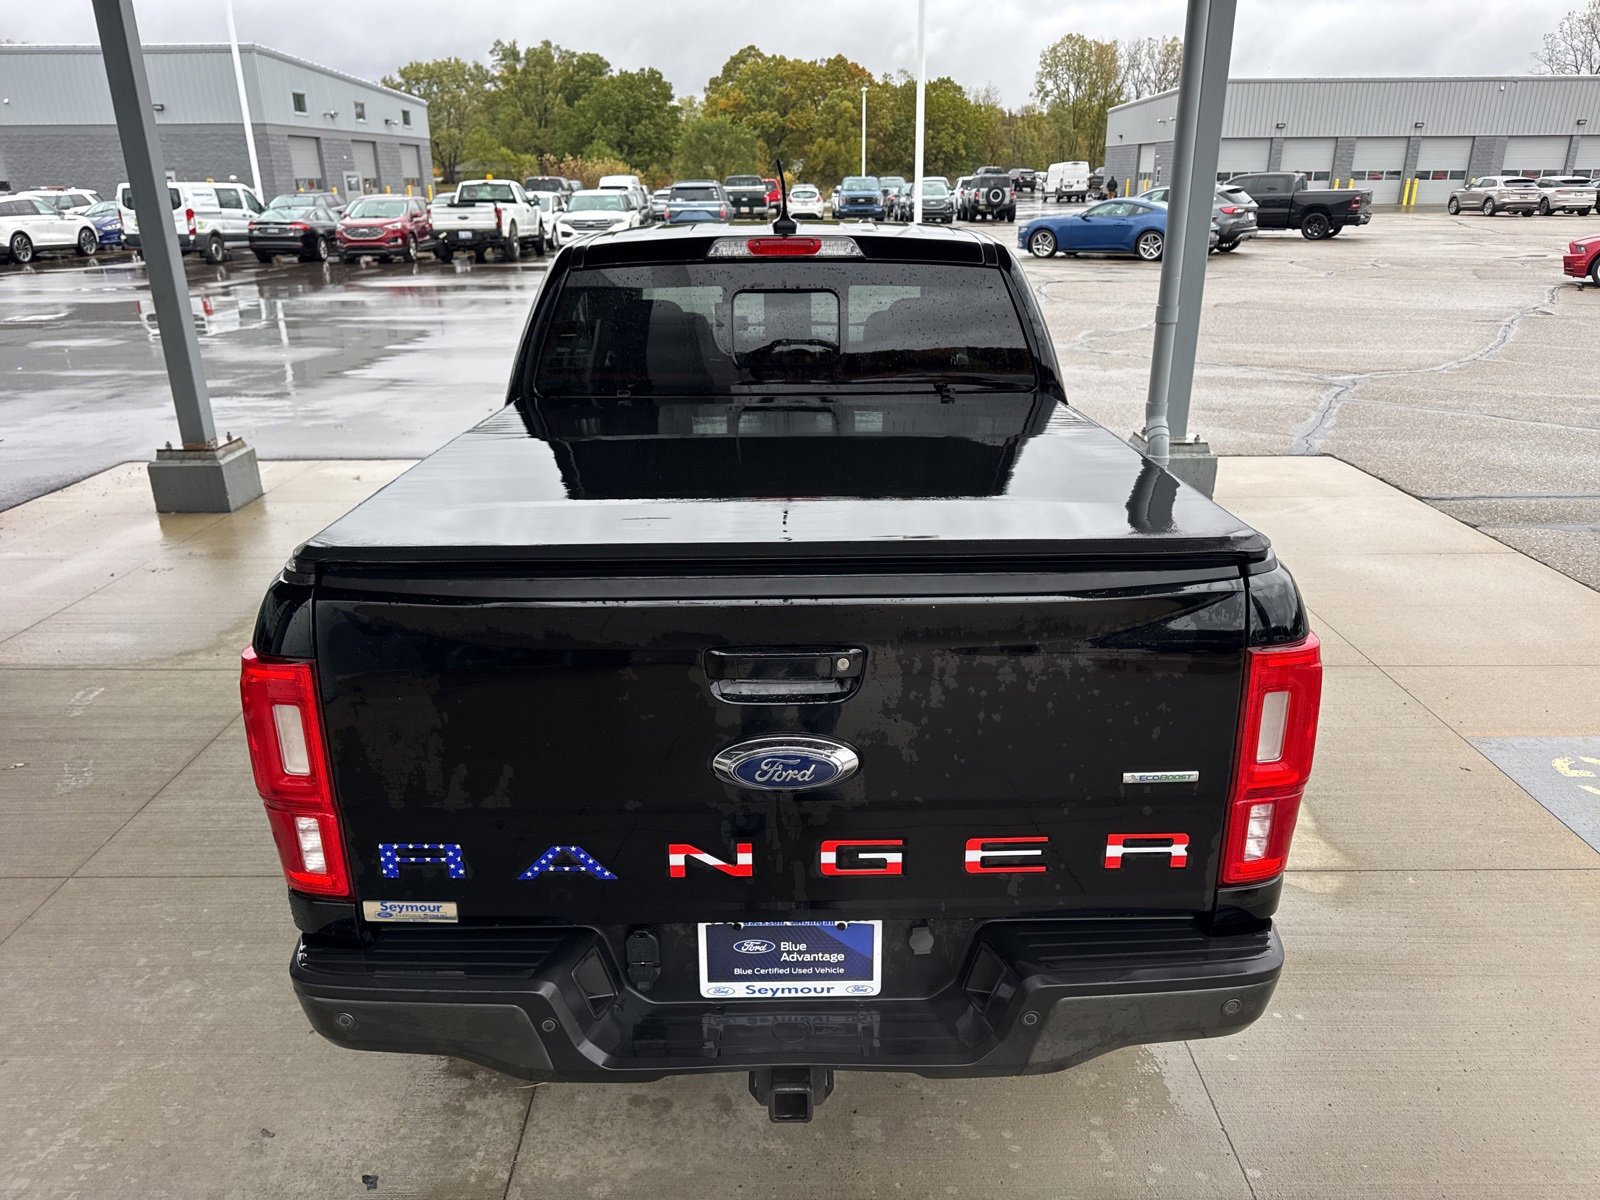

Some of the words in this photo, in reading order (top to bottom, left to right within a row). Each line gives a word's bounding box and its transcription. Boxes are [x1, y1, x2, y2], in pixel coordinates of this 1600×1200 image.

[755, 758, 816, 782] Ford
[378, 832, 1190, 879] RANGER
[380, 901, 443, 913] Seymour
[741, 941, 767, 951] Ford
[780, 941, 807, 951] Blue
[780, 952, 845, 963] Advantage
[733, 967, 753, 975] Blue
[745, 985, 835, 997] Seymour
